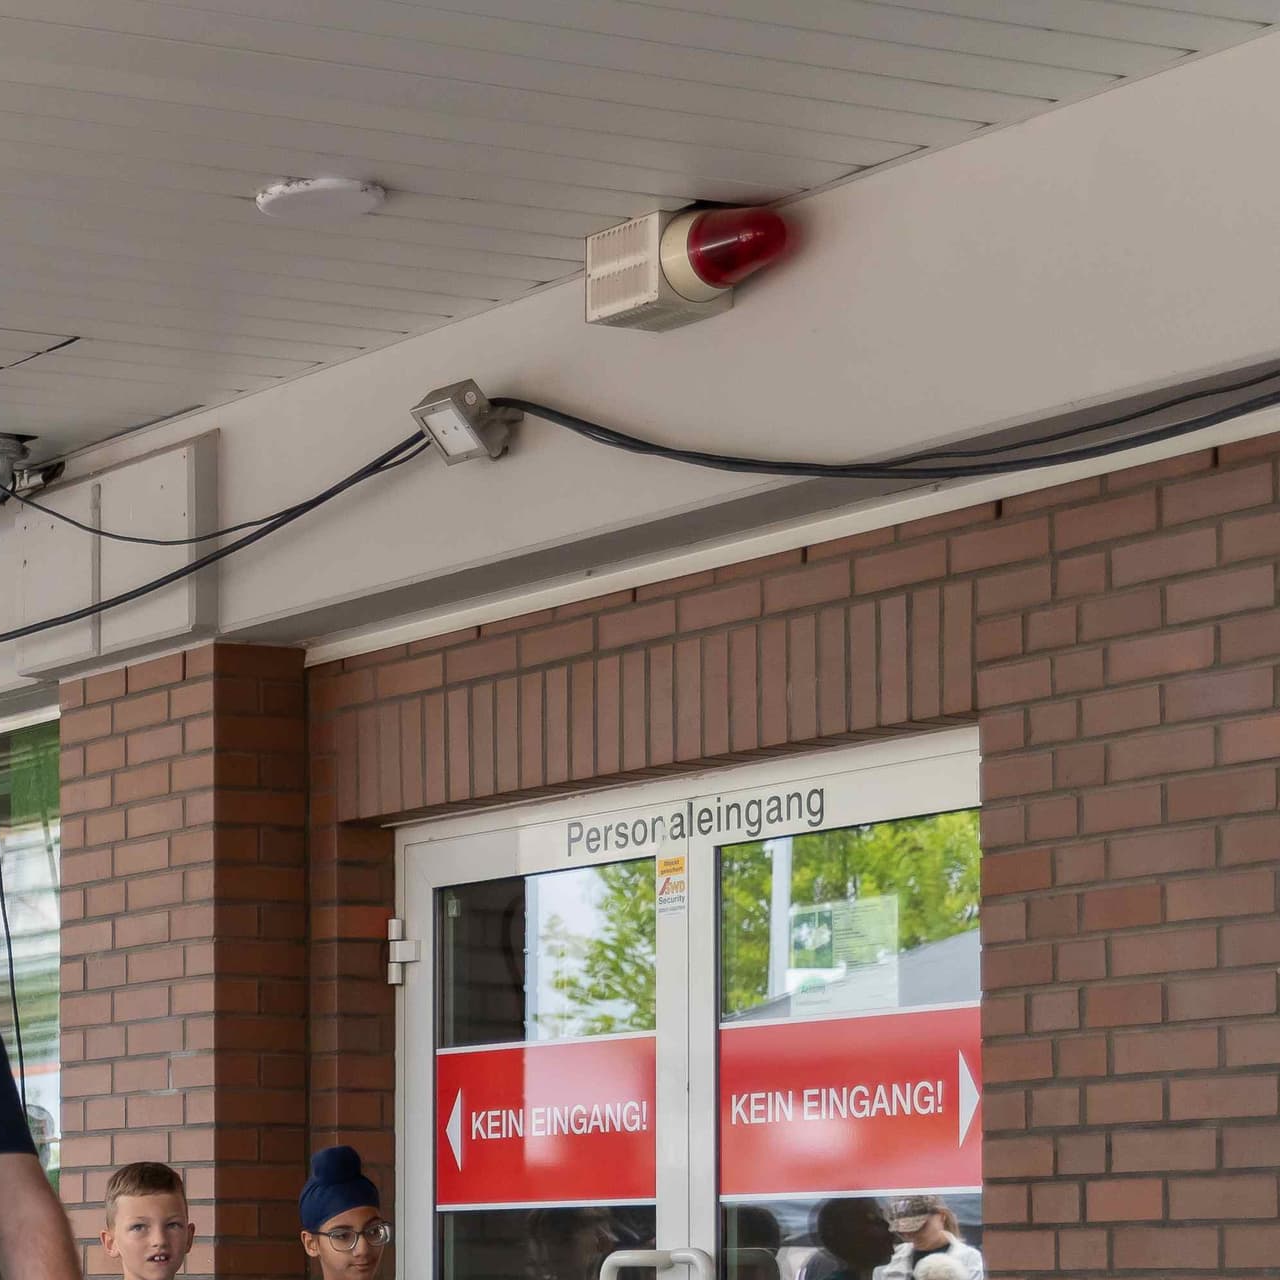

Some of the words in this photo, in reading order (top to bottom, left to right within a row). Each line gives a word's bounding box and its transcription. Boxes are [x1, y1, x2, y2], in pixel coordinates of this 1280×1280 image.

[658, 895, 686, 905] Security
[471, 1108, 524, 1140] KEIN
[531, 1100, 648, 1137] EINGANG!
[731, 1090, 793, 1125] KEIN
[802, 1080, 944, 1121] EINGANG!
